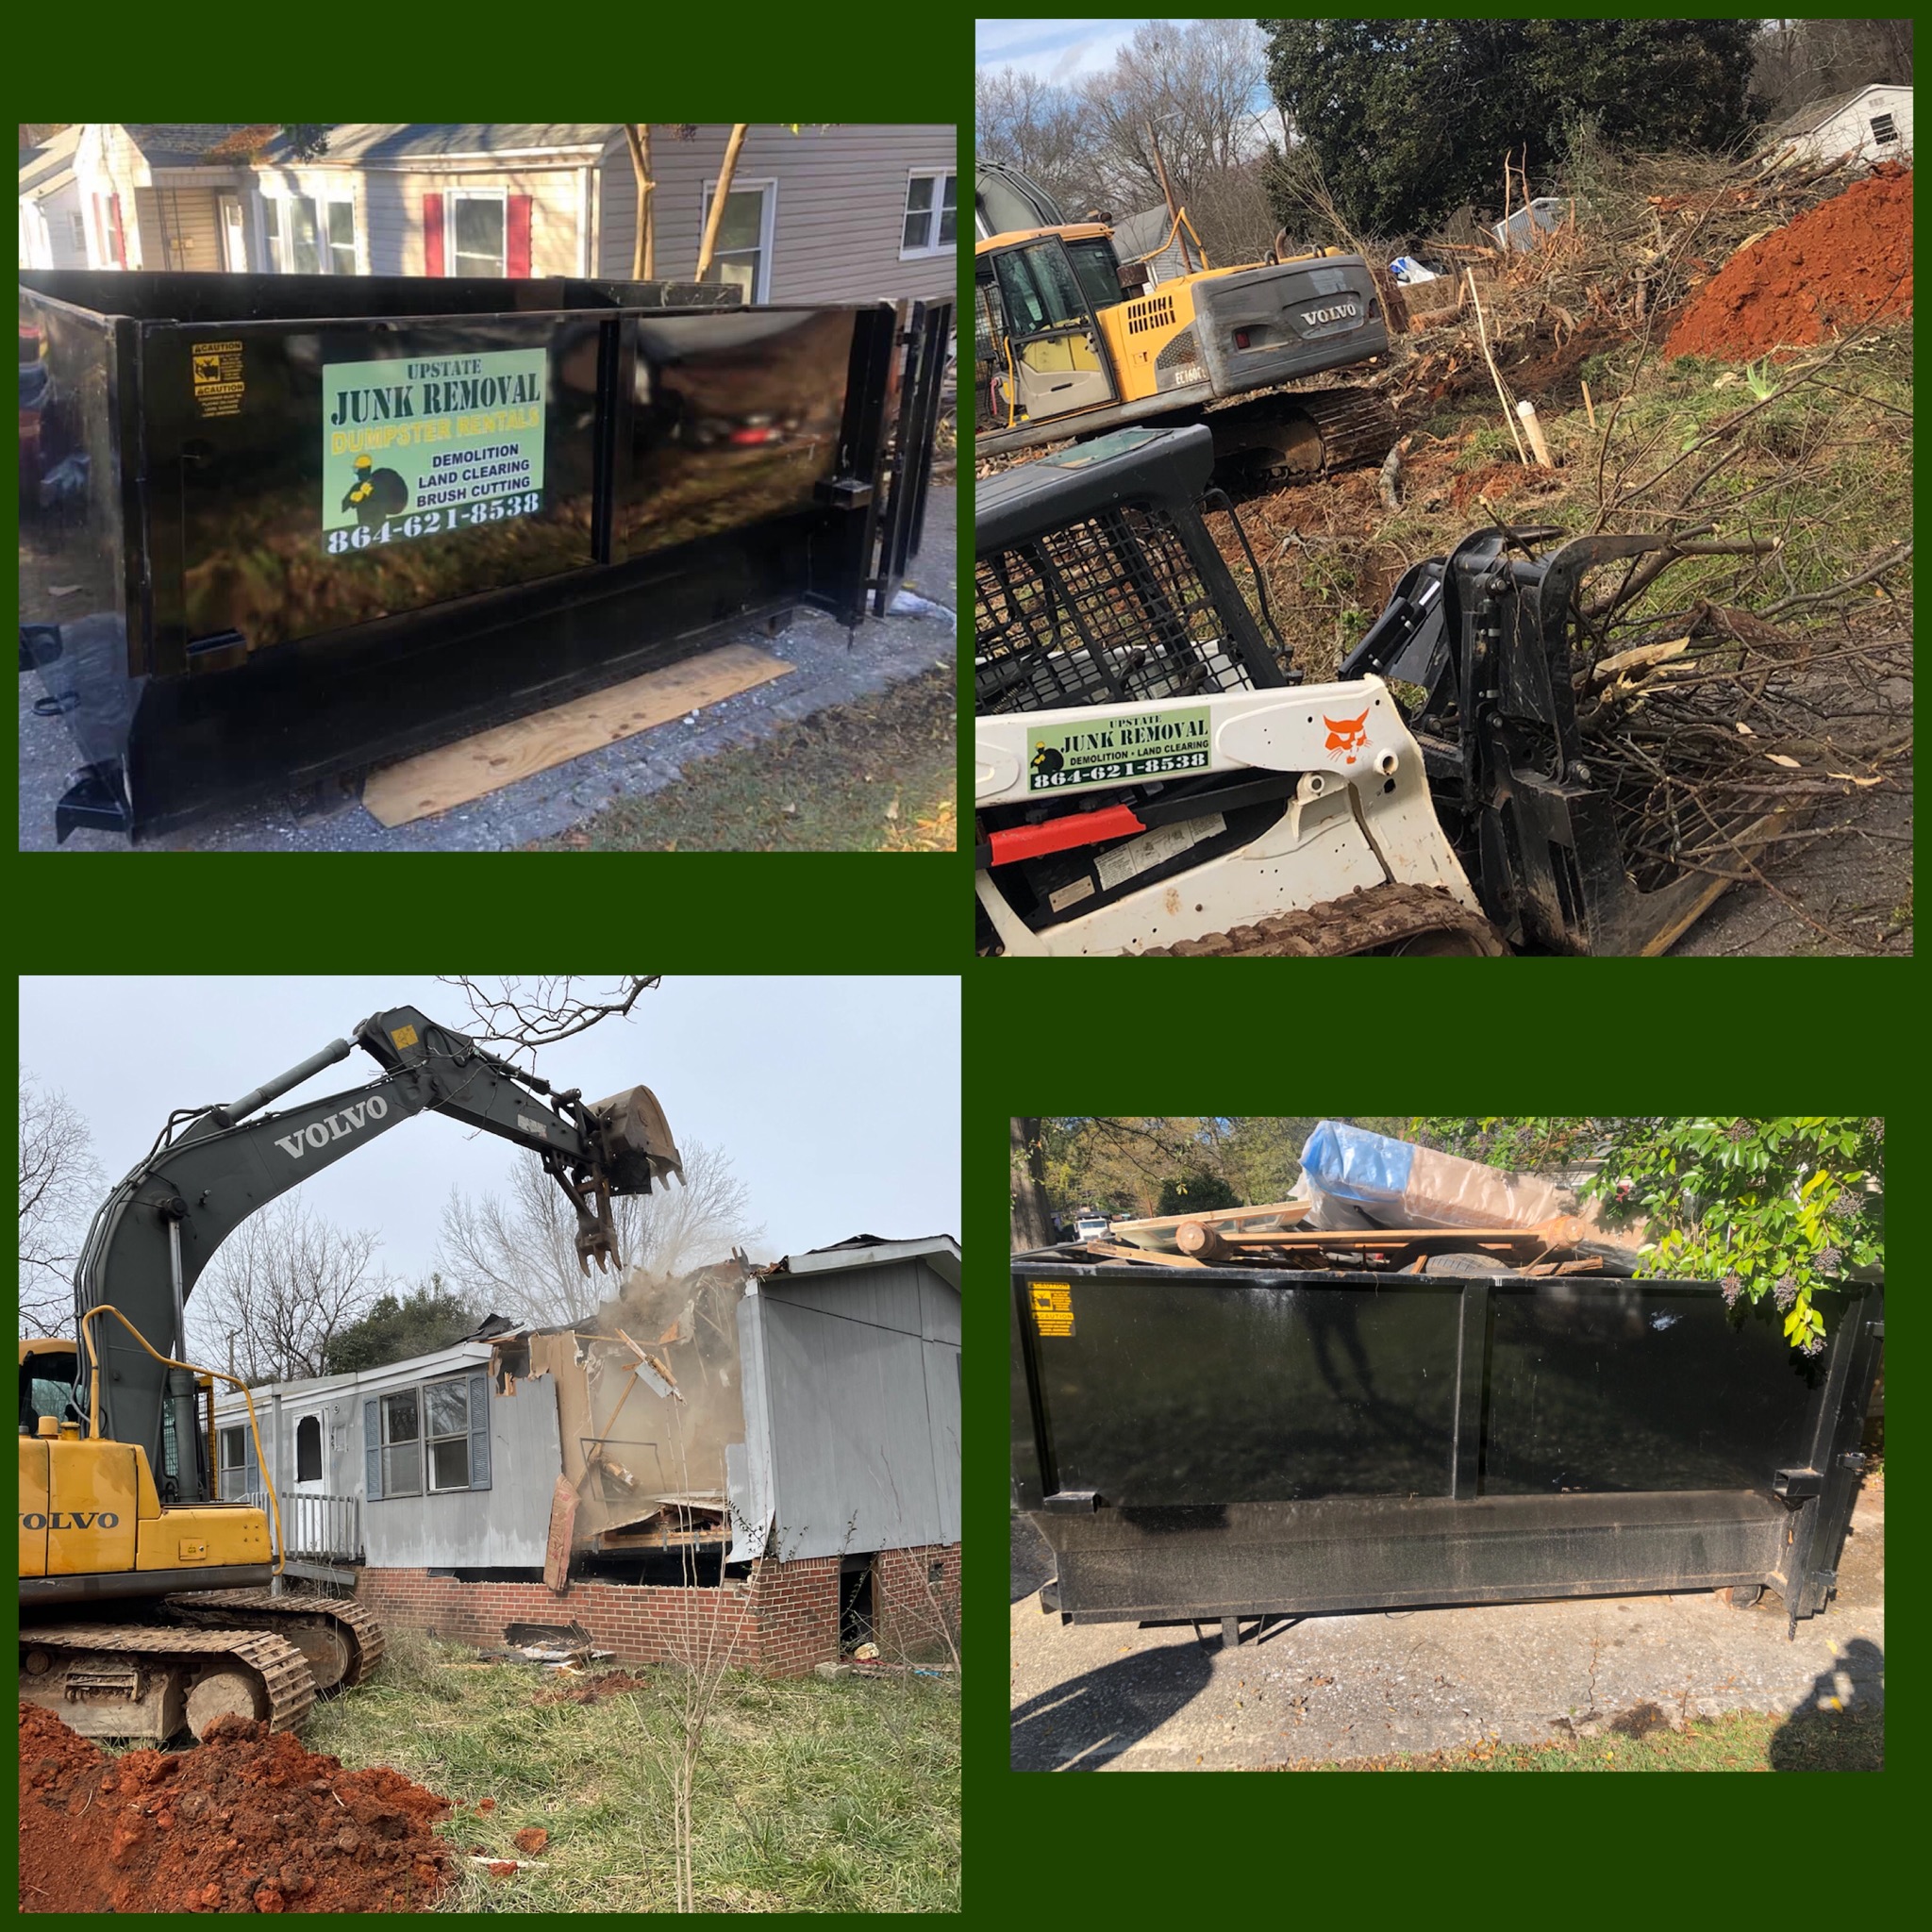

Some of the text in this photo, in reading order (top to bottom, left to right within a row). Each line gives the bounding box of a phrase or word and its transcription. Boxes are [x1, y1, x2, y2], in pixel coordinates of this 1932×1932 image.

[1300, 303, 1357, 326] VOLVO
[201, 342, 241, 351] CAUTION
[408, 358, 482, 380] UPSTATE
[205, 385, 243, 393] CAUTION
[331, 373, 541, 425] JUNK REMOVAL
[331, 407, 541, 456] DUMPSTER RENTALS
[432, 443, 520, 468] DEMOLITION
[418, 459, 530, 490] LAND CLEARING
[417, 476, 531, 508] BRUSH CUTTING
[327, 491, 540, 555] 864-621-8538
[1060, 720, 1208, 754] JUNK REMOVAL
[1109, 715, 1162, 729] UPSTATE
[1070, 740, 1209, 766] DEMOLITION LAND CLEARING
[1034, 752, 1206, 789] 864-621-8538
[274, 1095, 388, 1159] VOLVO
